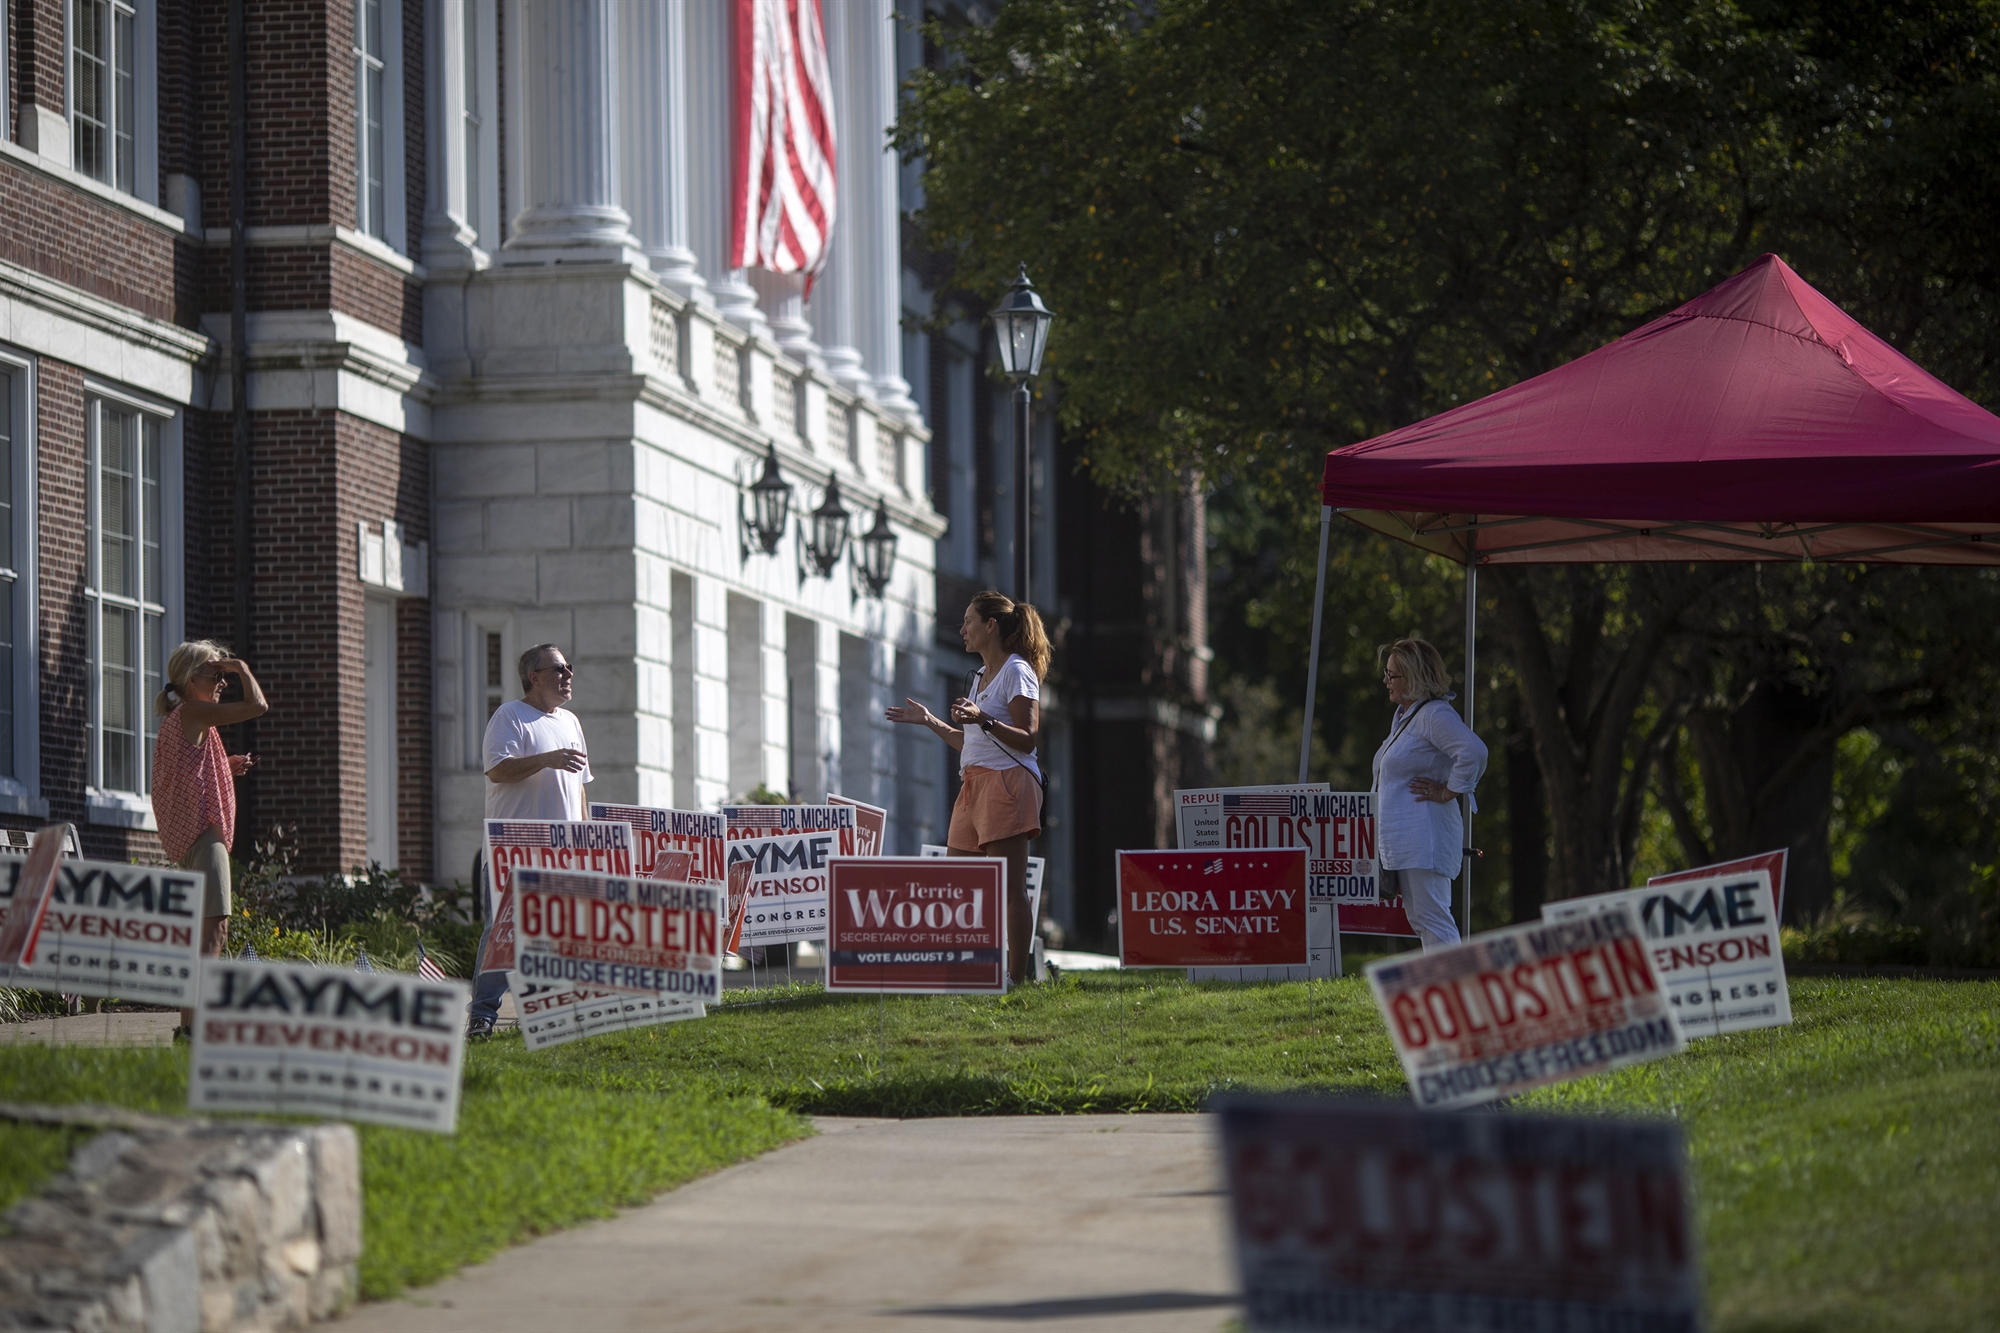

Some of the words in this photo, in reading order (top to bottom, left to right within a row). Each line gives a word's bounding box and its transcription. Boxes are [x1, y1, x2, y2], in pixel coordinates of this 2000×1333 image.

[781, 808, 799, 828] DR.
[801, 808, 853, 829] MICHAEL
[1290, 795, 1311, 817] DR.
[1314, 795, 1374, 818] MICHAEL
[650, 810, 670, 833] DR.
[671, 812, 723, 839] MICHAEL
[1194, 819, 1219, 827] United
[549, 824, 571, 849] DR.
[571, 824, 628, 850] MICHAEL
[1226, 815, 1375, 859] GOLDSTEIN
[728, 837, 833, 875] AYME
[1310, 861, 1351, 873] GRESS
[638, 881, 715, 912] MICHAEL
[747, 874, 827, 899] VENSO
[906, 882, 964, 899] Terrie
[1310, 875, 1375, 898] REEDOM
[843, 888, 986, 930] Wood
[1131, 889, 1220, 912] LEORA
[1230, 889, 1297, 911] LEVY
[1642, 881, 1766, 938] YME
[522, 893, 716, 957] GOLDSTEIN
[743, 908, 827, 924] CONGRES
[1149, 917, 1187, 935] U.S.
[1195, 915, 1280, 935] SENATE
[840, 932, 907, 943] SECRETARY
[910, 933, 927, 943] OF
[929, 934, 952, 944] THE
[955, 934, 990, 944] STATE
[48, 952, 190, 979] CONGRESS
[857, 953, 891, 963] VOTE
[893, 951, 944, 963] AUGUST
[946, 951, 955, 962] 9
[1654, 934, 1772, 972] ENSON
[205, 968, 456, 1034] JAYME
[1392, 936, 1656, 1048] GOLDSTEIN
[1670, 981, 1778, 1007] NGRESS
[575, 999, 693, 1022] CONGRES
[203, 1019, 451, 1066] STEVENSON
